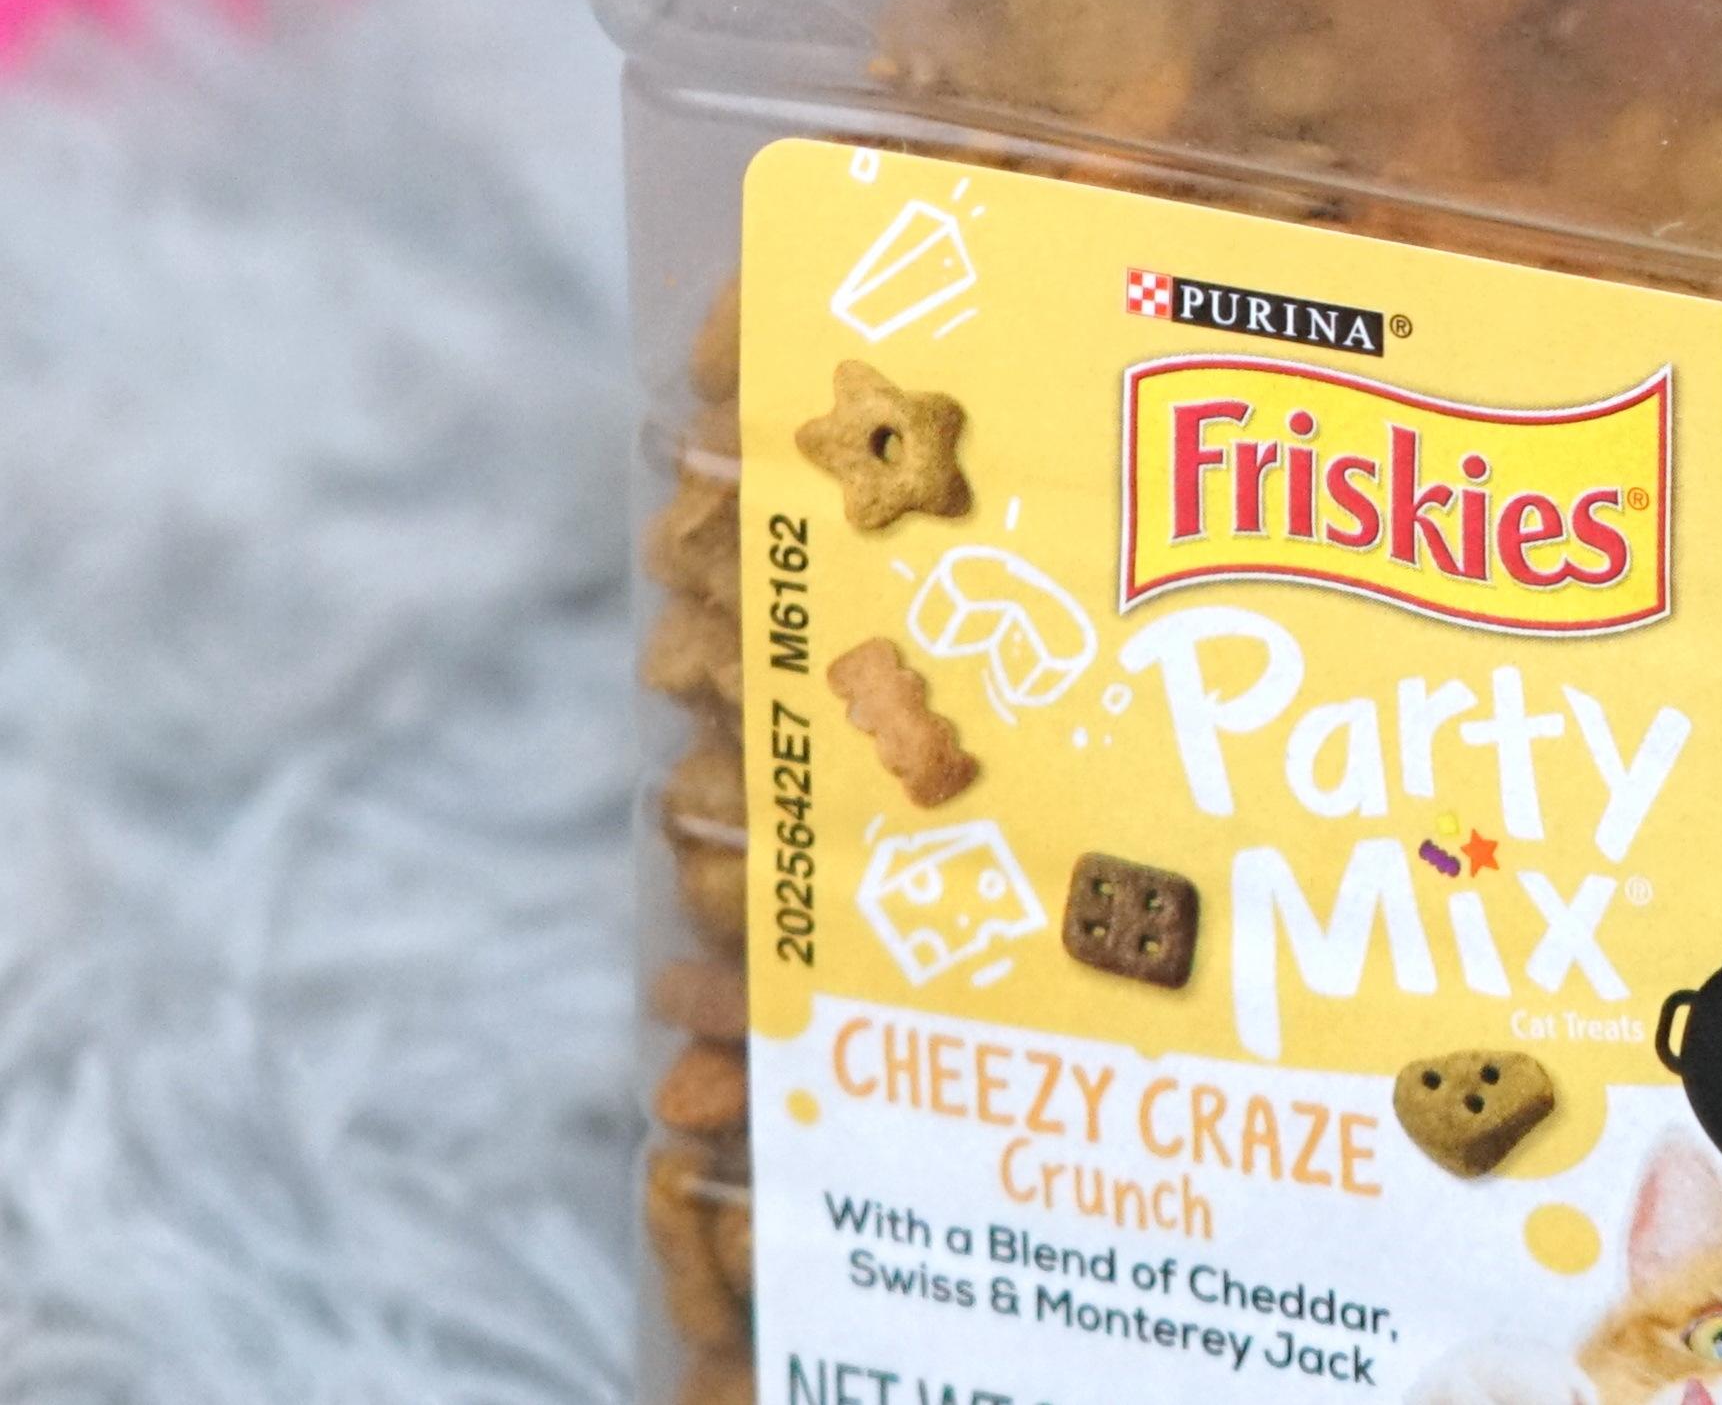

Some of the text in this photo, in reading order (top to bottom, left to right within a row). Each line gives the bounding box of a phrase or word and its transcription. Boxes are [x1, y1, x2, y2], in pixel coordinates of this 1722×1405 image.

[768, 513, 816, 968] 2025642E7 M6162
[1118, 604, 1692, 864] Party
[1510, 1009, 1646, 1044] Cat Treats
[832, 1017, 1383, 1196] CHEEZY CRAZE
[999, 1136, 1214, 1240] Crunch
[823, 1190, 1400, 1343] With a Blend of Cheddar,
[848, 1249, 1378, 1387] Swiss & Monterey Jack
